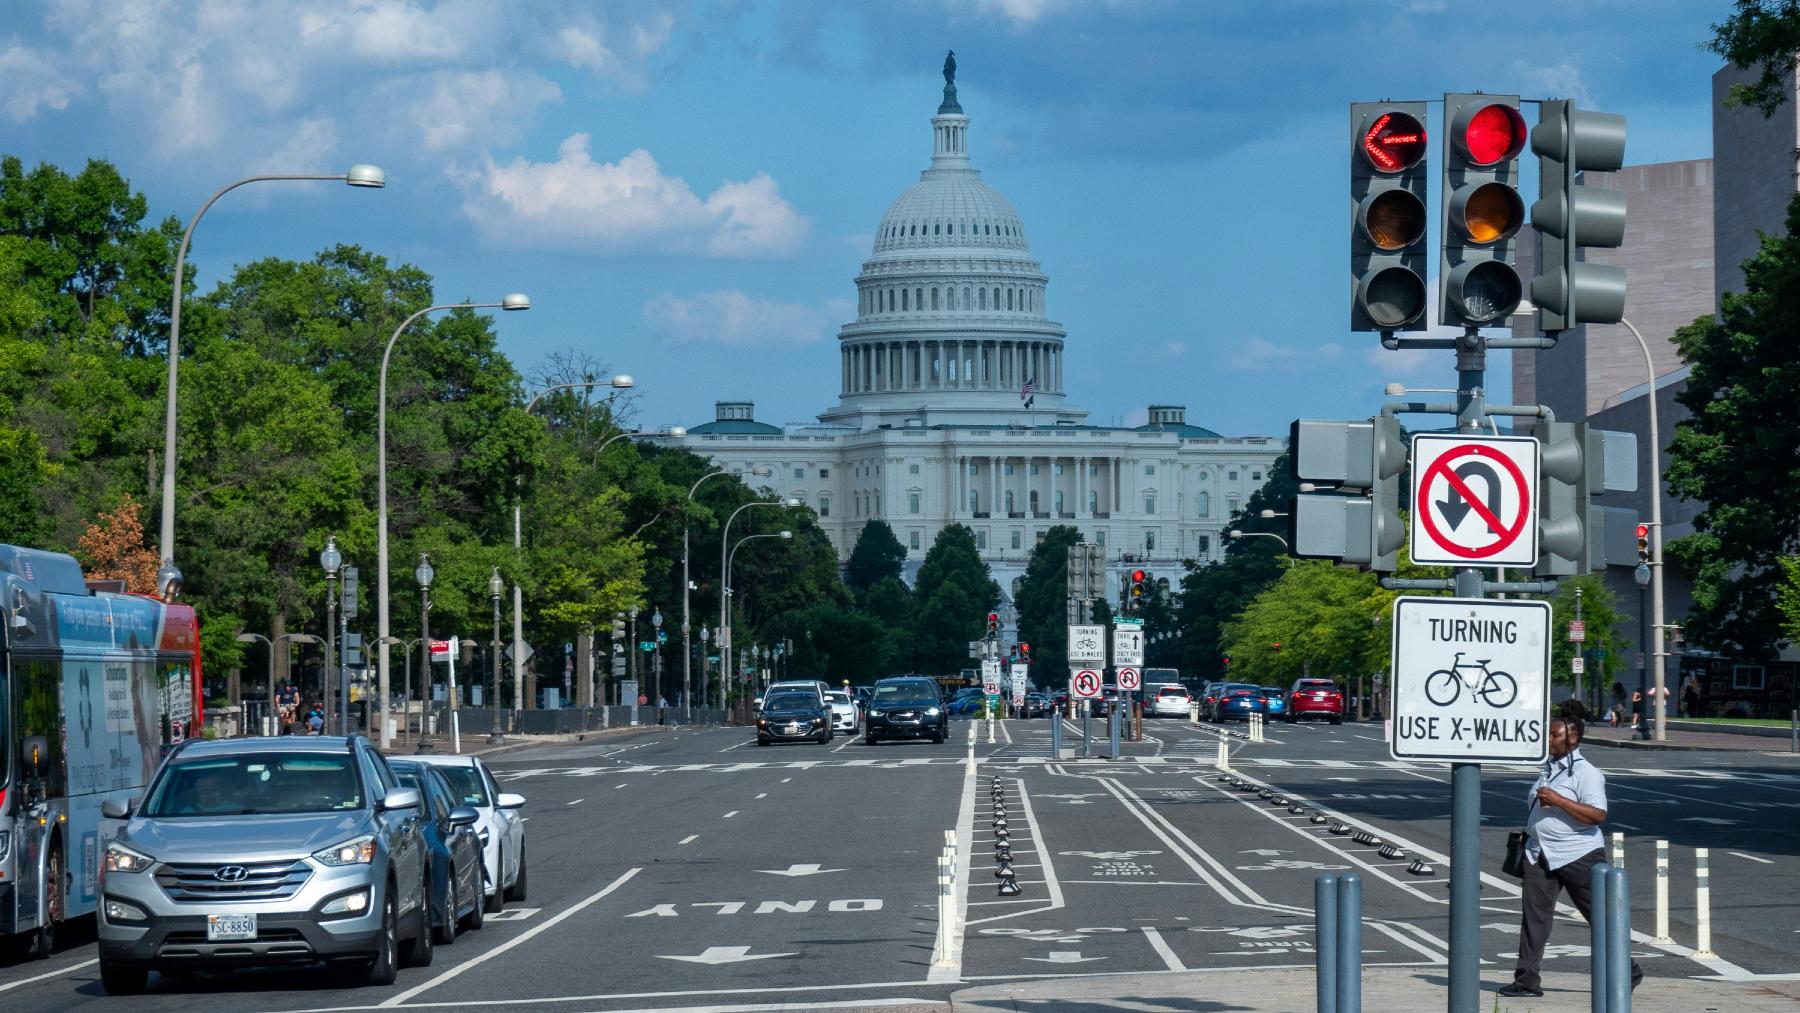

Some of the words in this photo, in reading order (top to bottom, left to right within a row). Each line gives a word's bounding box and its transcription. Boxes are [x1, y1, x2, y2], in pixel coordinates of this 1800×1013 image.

[1429, 618, 1517, 644] TURNING
[1400, 716, 1440, 740] USE
[1451, 717, 1540, 743] X-WALKS
[623, 898, 884, 917] ONLY
[210, 920, 254, 933] VSC-8850
